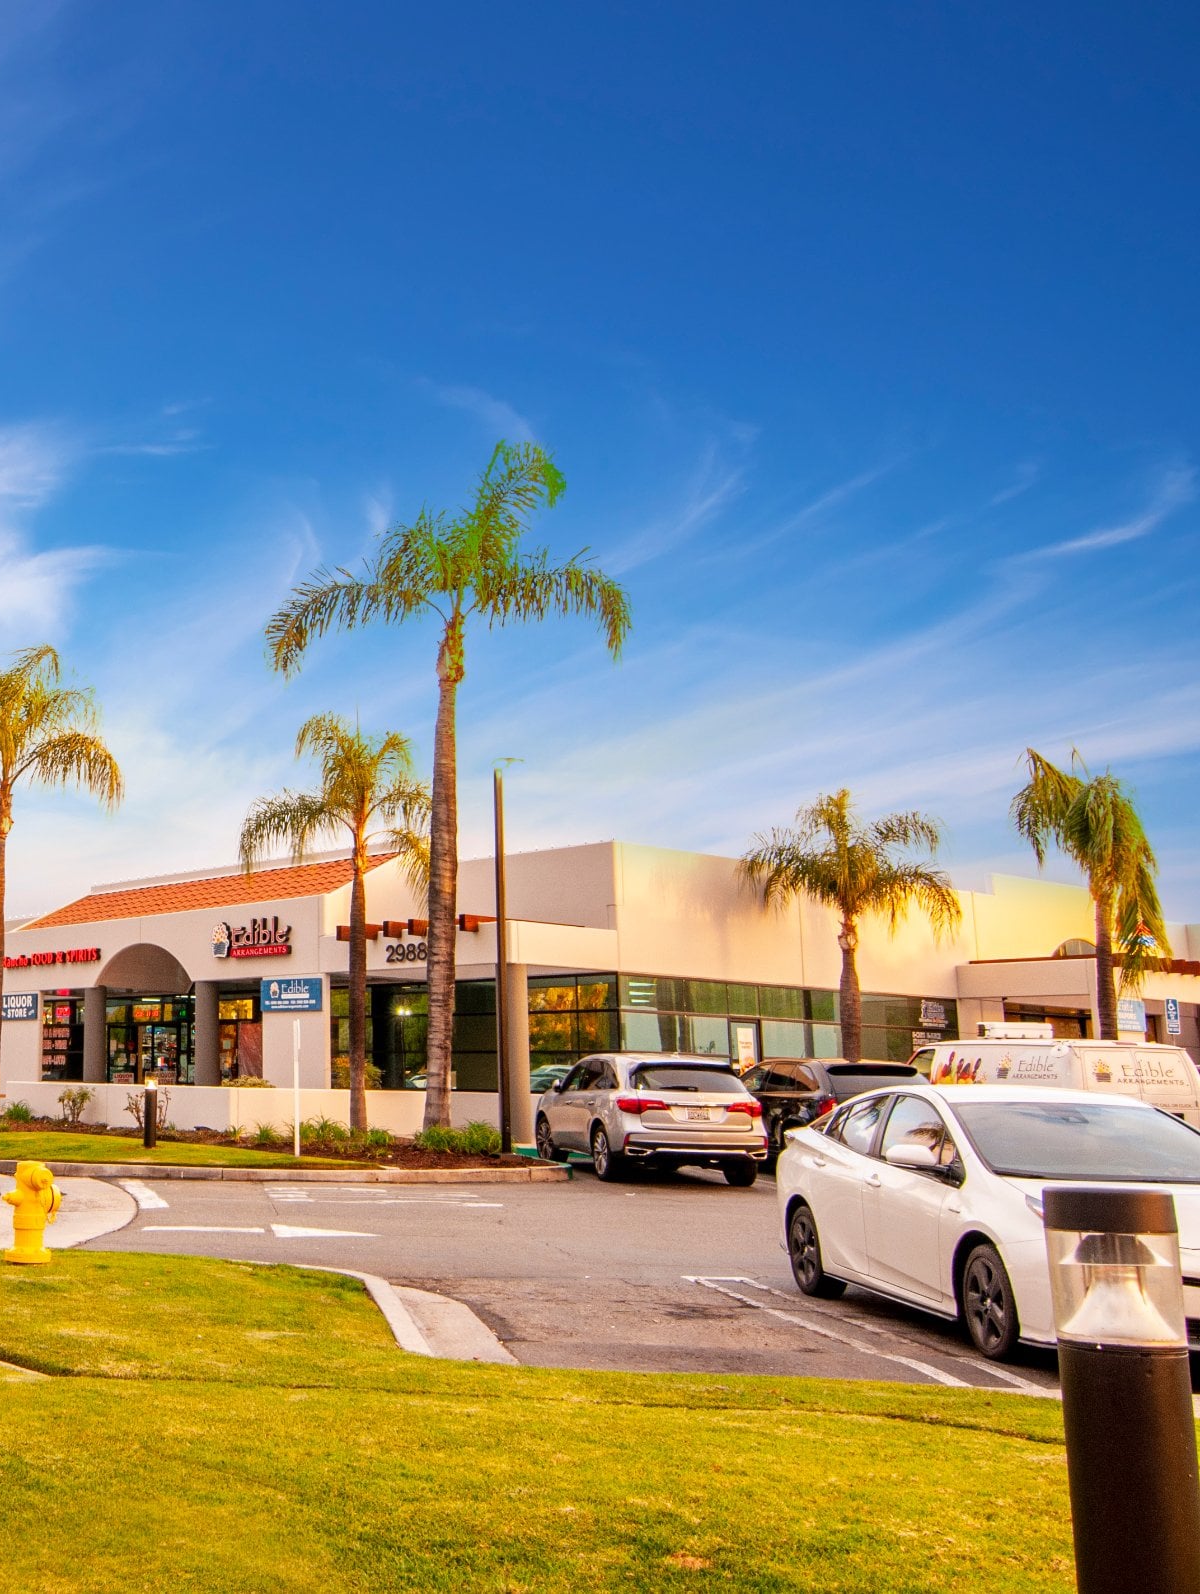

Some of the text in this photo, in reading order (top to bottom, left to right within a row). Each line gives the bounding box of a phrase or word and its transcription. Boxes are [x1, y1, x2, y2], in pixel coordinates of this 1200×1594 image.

[231, 917, 290, 946] Edible
[31, 952, 55, 966] FOOD
[56, 951, 64, 964] &
[66, 948, 99, 963] SPIRITS
[232, 946, 287, 956] ARRANGEMENTS
[386, 942, 428, 963] 2988
[281, 979, 309, 994] Edible
[3, 995, 32, 1009] LIQUOR
[7, 1008, 27, 1019] STORE
[1017, 1055, 1055, 1072] Edible
[1121, 1060, 1175, 1078] Edible
[1116, 1078, 1185, 1086] ARRANGEMENTS
